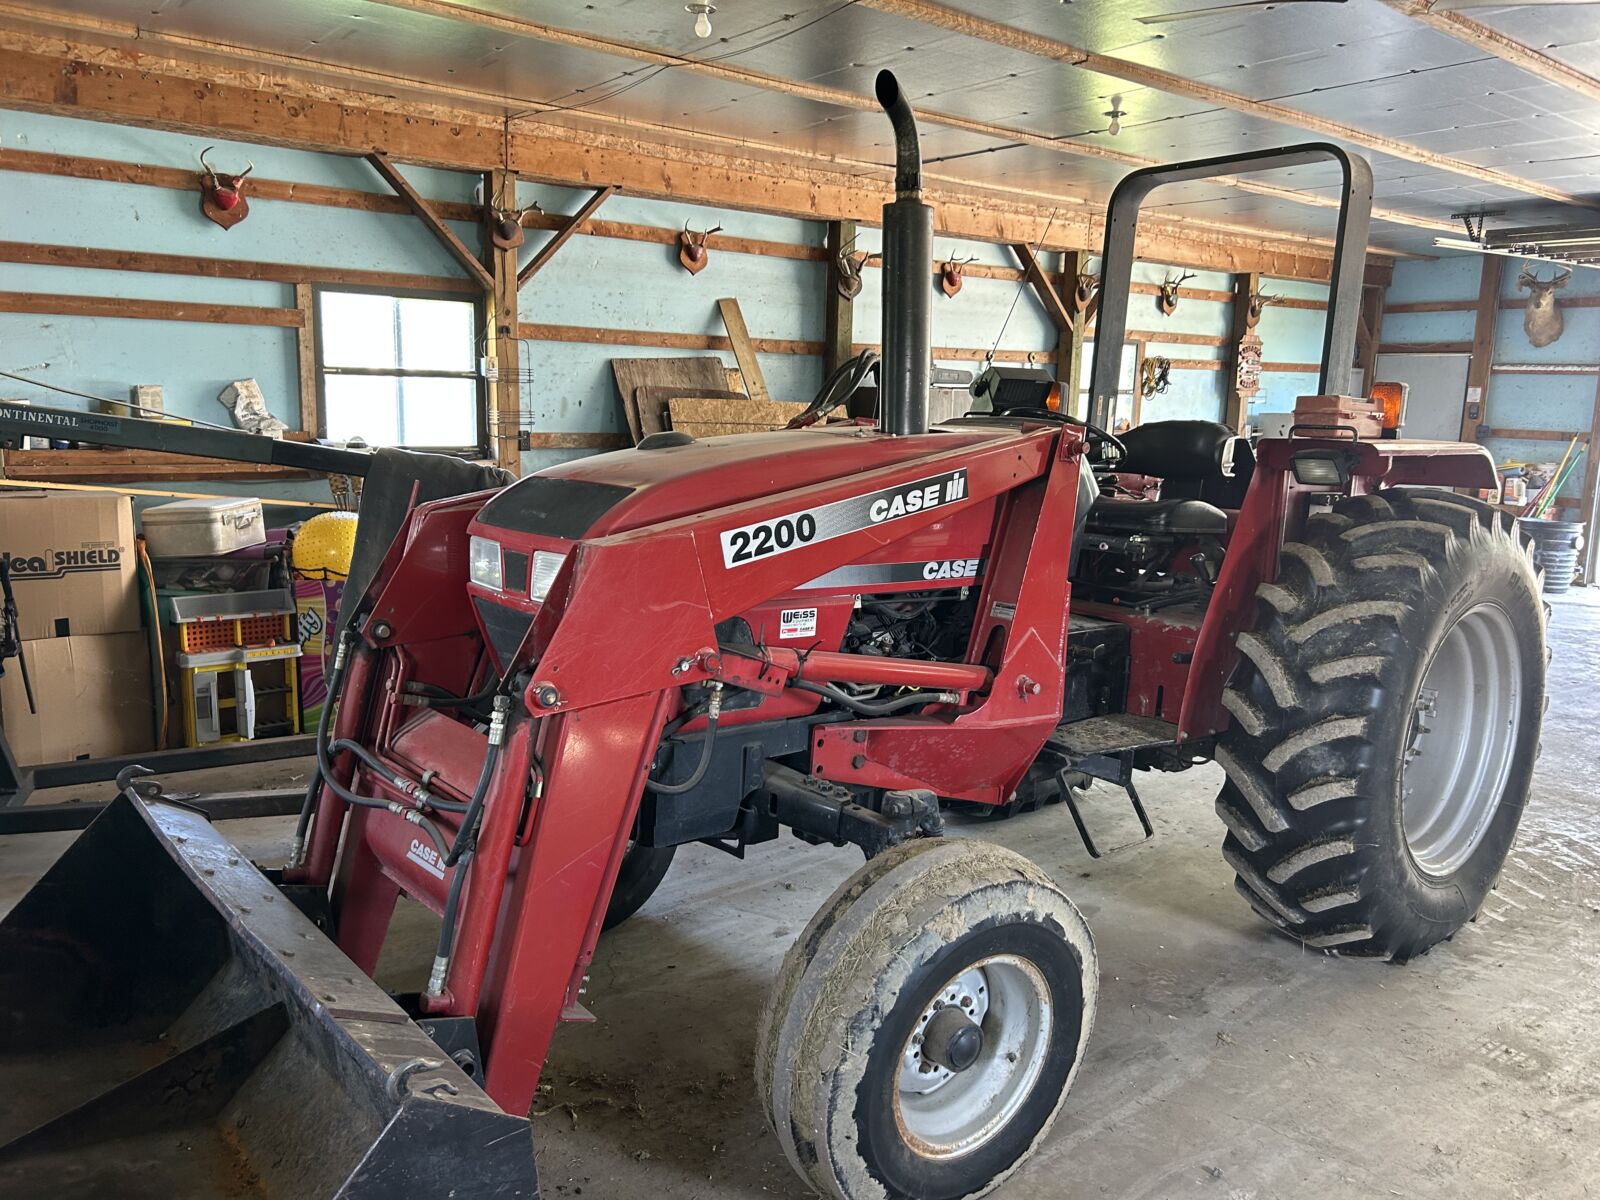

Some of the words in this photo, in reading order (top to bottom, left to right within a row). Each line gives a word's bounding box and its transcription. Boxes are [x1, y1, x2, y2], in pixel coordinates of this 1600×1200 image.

[869, 484, 940, 522] CASE
[730, 513, 816, 564] 2200
[54, 550, 120, 566] SHIELD
[923, 559, 979, 580] CASE
[410, 839, 438, 866] CASE
